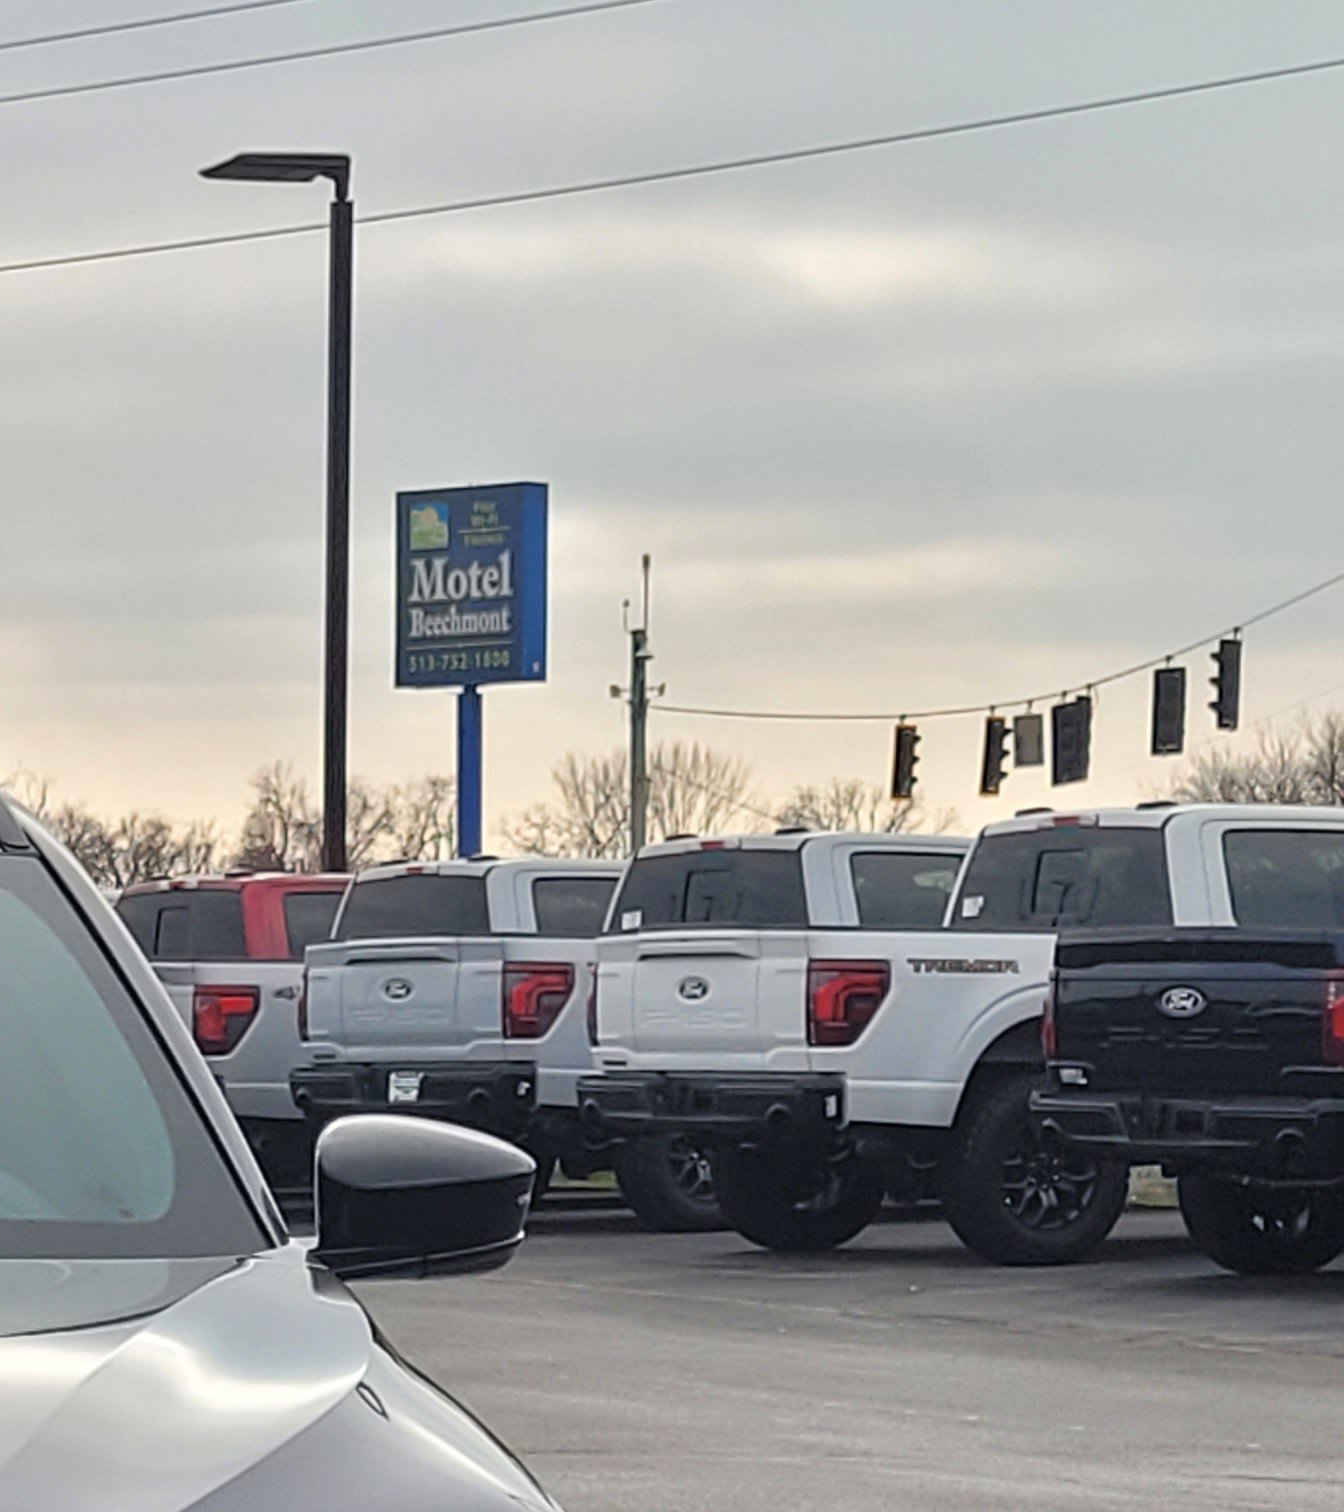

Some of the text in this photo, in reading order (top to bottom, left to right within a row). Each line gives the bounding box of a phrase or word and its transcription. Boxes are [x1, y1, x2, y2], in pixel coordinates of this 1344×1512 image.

[408, 550, 514, 602] Motel
[408, 603, 511, 638] Beechmont
[907, 958, 1020, 974] TREMOR
